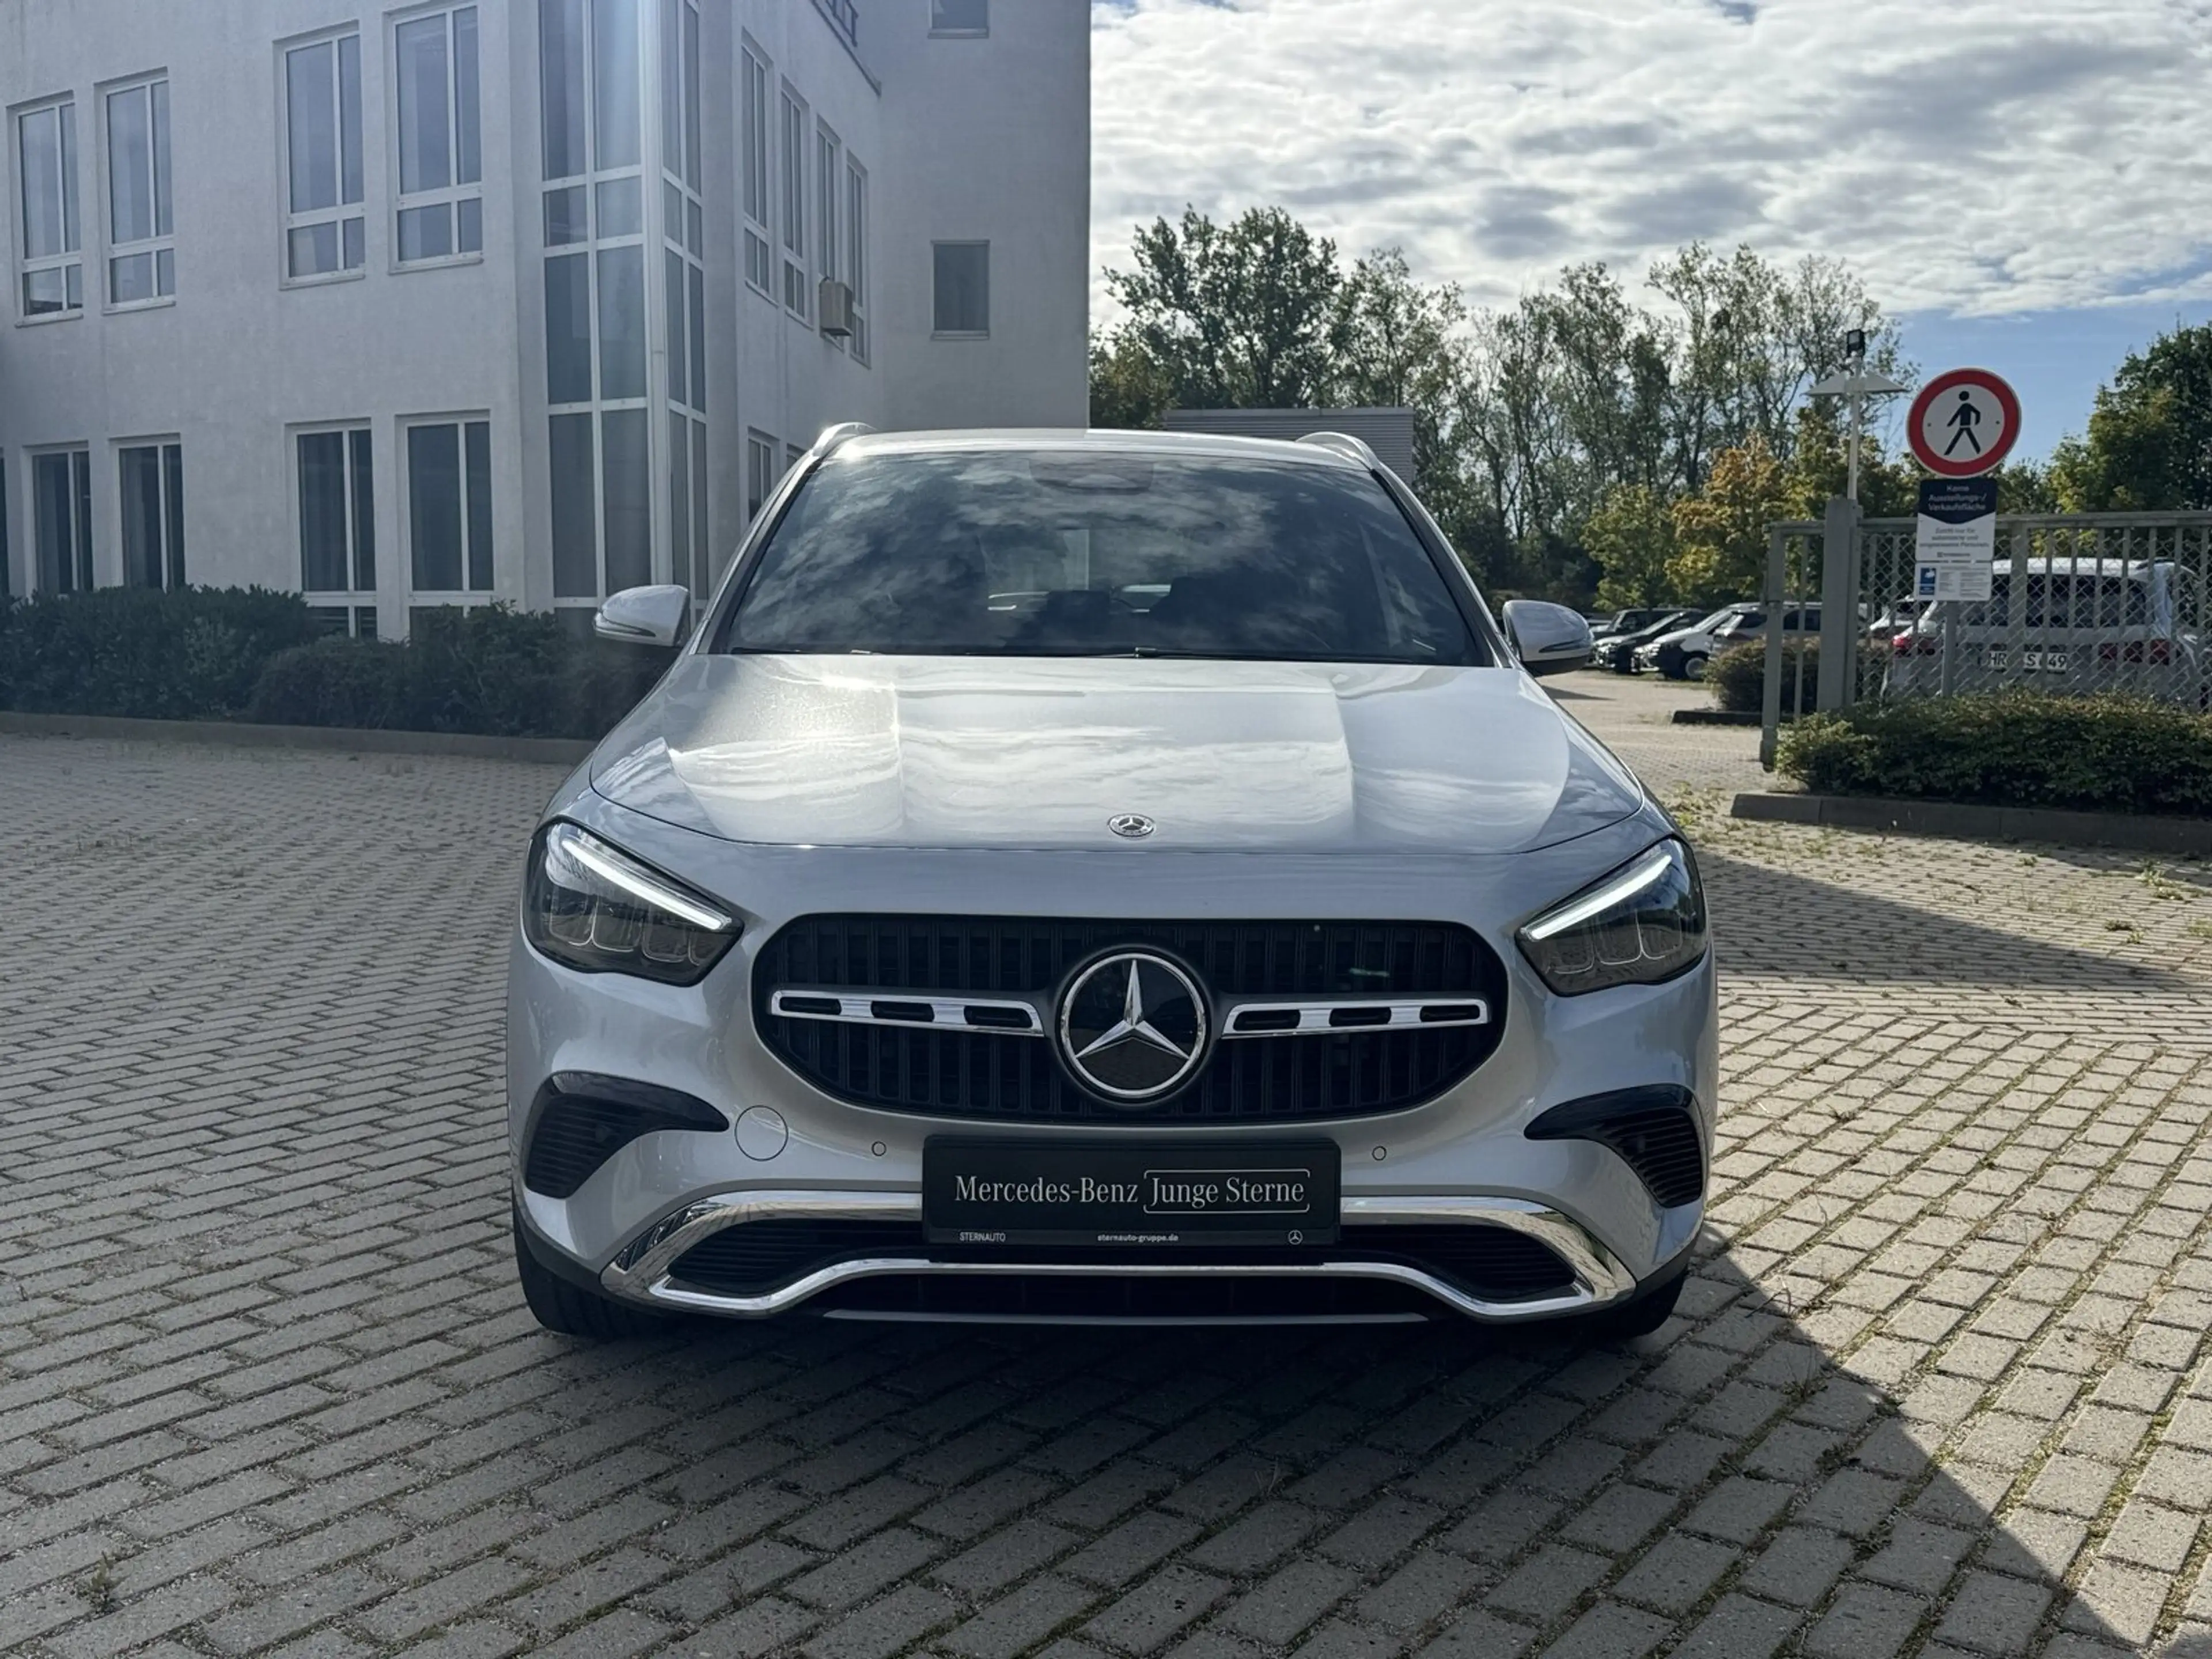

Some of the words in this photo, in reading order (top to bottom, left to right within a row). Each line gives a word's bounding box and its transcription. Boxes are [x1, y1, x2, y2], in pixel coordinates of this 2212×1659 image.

[955, 1175, 1139, 1203] Mercedes-Benz
[1151, 1177, 1219, 1209] Junge
[1226, 1176, 1305, 1203] Sterne
[959, 1232, 1006, 1242] STERNAUTO
[1097, 1233, 1179, 1243] sternauto-gruppe.de
